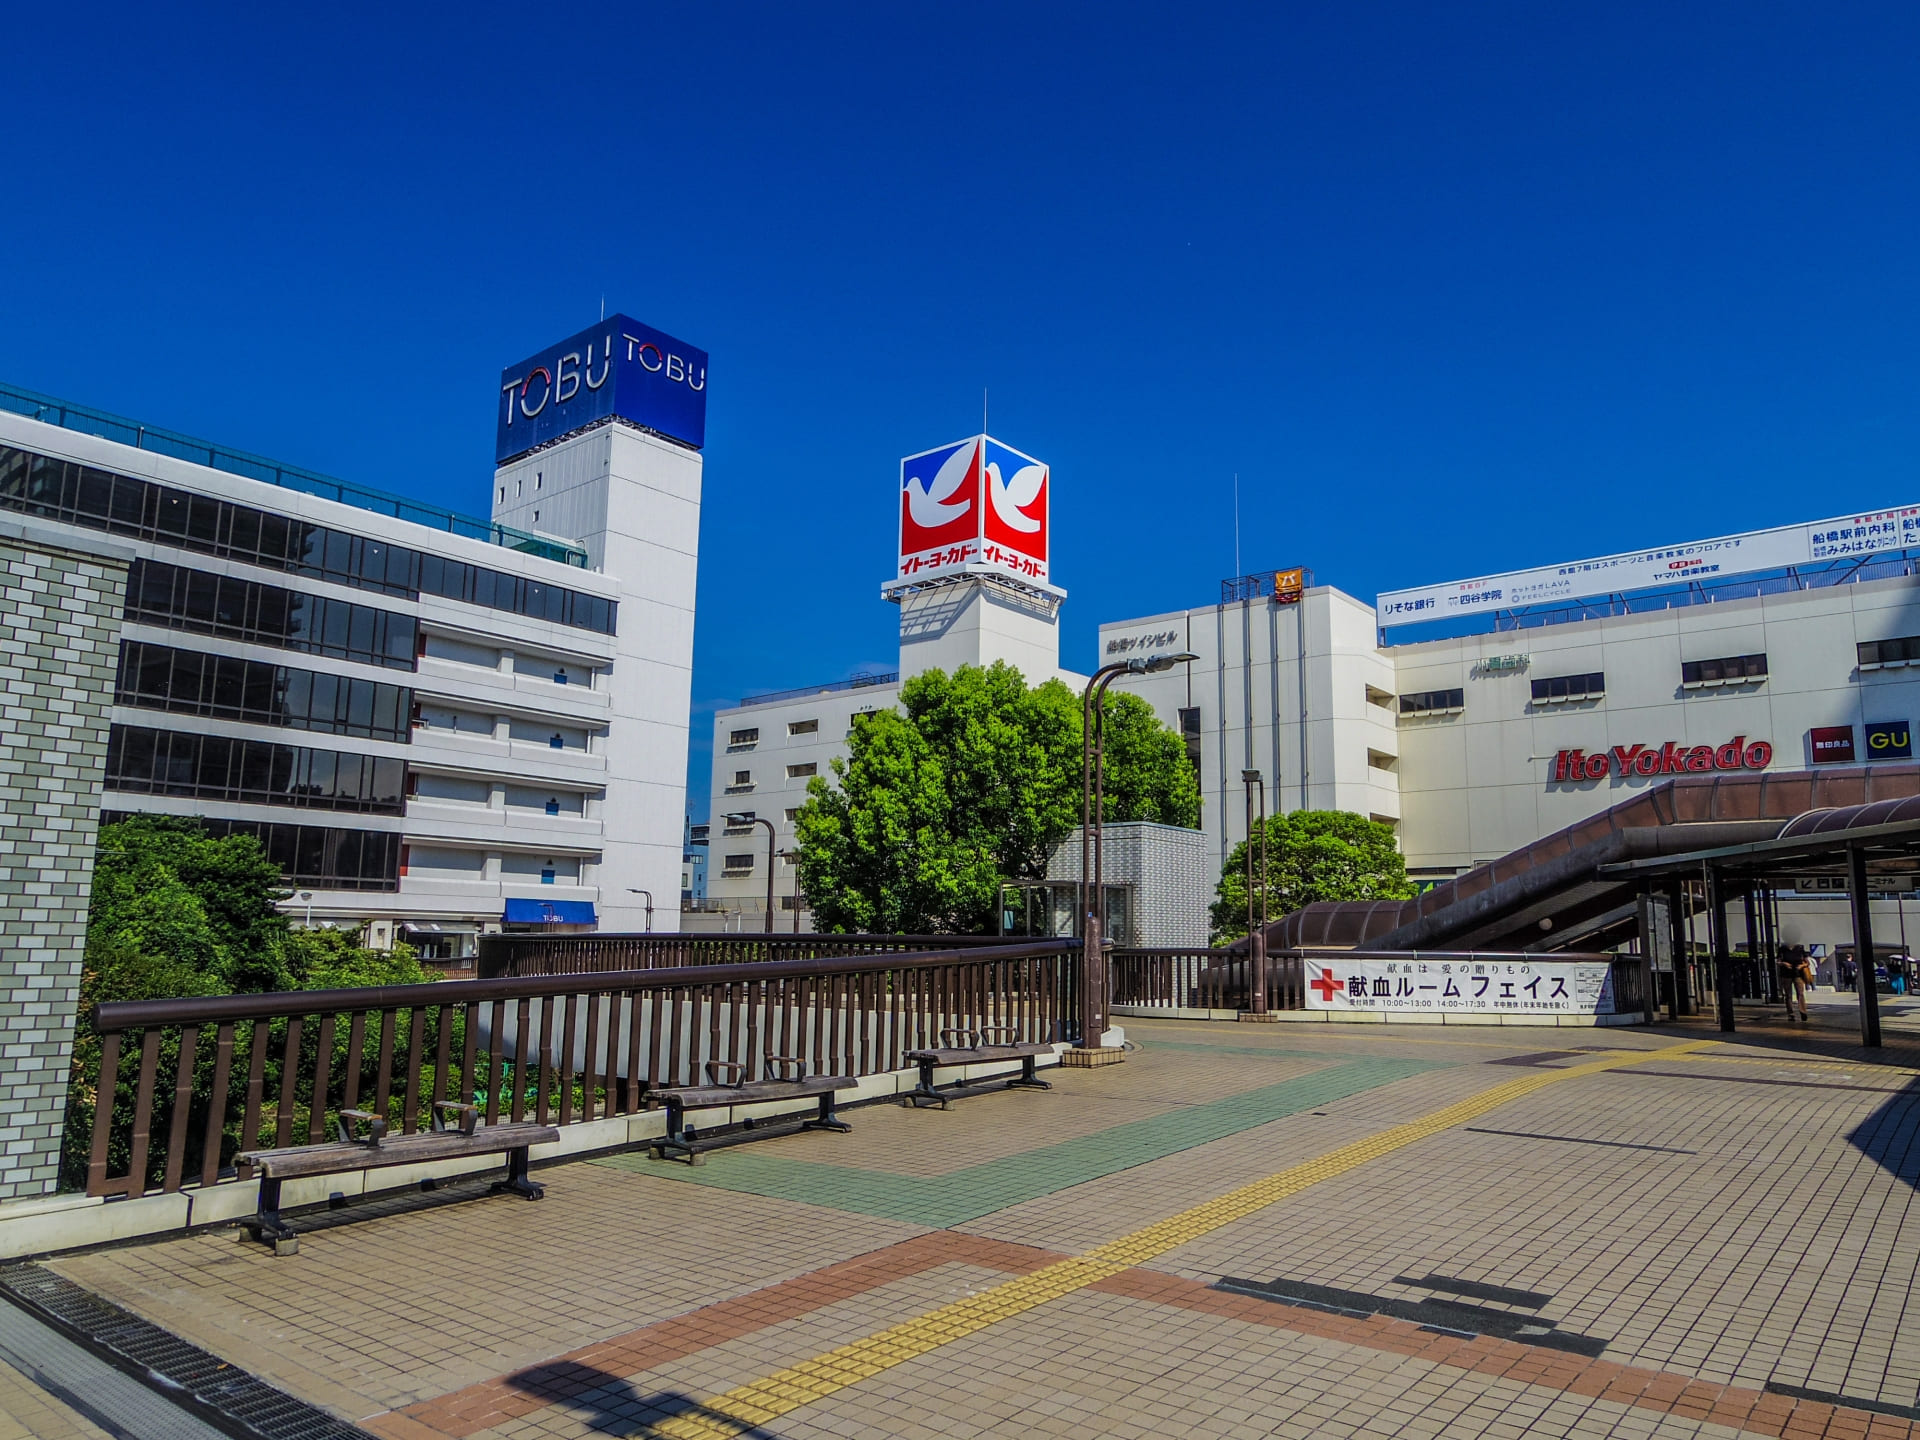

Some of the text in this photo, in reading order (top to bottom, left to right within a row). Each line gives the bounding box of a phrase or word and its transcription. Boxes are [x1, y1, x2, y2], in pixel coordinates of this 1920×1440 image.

[622, 333, 705, 392] TOBU
[502, 335, 611, 426] TOBU
[1812, 521, 1896, 545] 船橋駅前内科
[901, 544, 978, 575] イトーヨーカドー
[983, 545, 1046, 578] イトーヨーカドー
[1653, 564, 1720, 581] ヤマハ音楽教室
[1385, 597, 1436, 615] りそな銀行
[1460, 589, 1503, 605] 四谷学院
[1815, 739, 1850, 750] 無印良品
[1869, 731, 1909, 749] GU
[1387, 963, 1530, 975] 献血は 愛の贈りもの
[1348, 975, 1569, 999] 献血ルームフェイス
